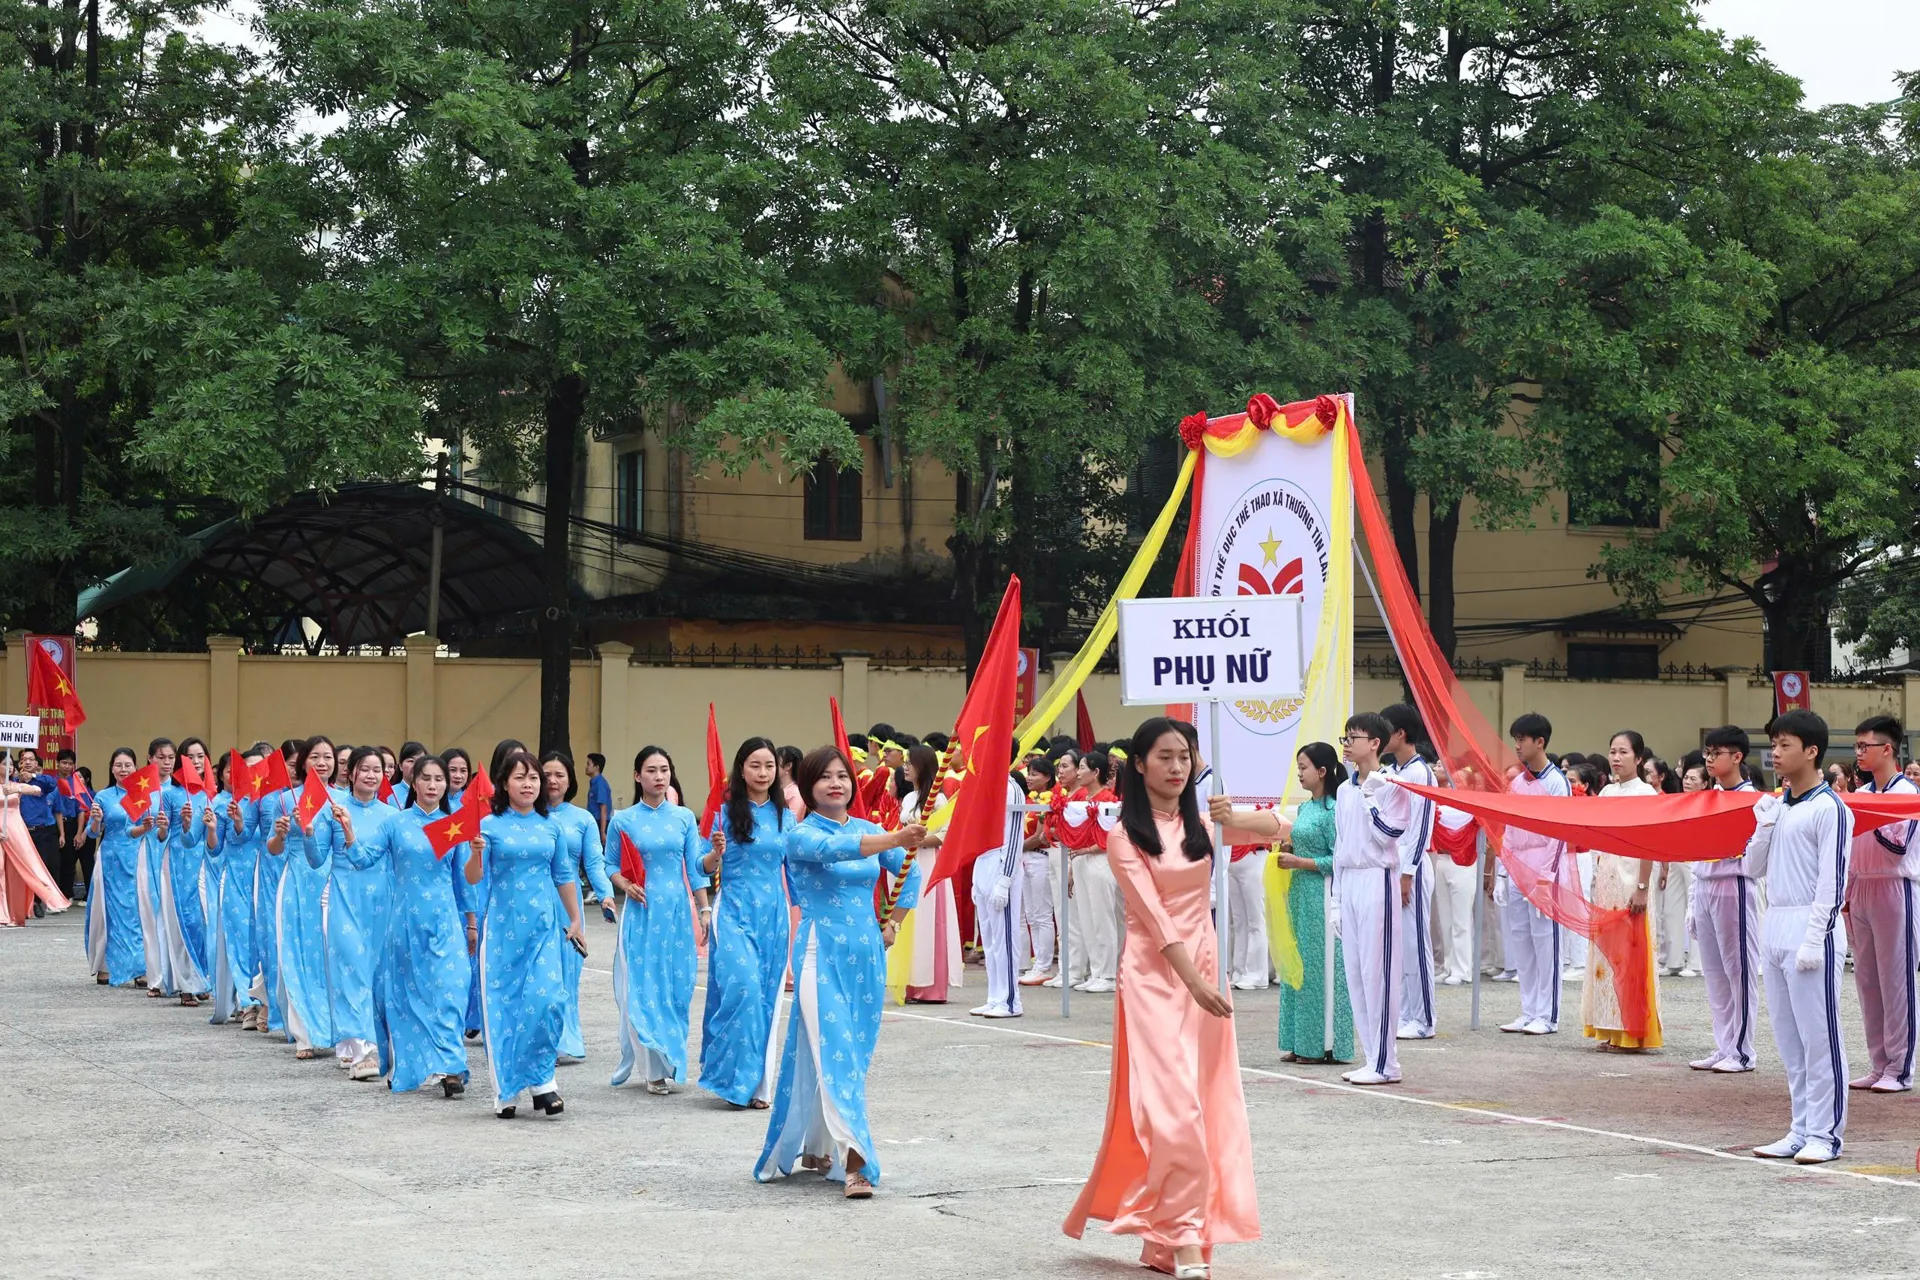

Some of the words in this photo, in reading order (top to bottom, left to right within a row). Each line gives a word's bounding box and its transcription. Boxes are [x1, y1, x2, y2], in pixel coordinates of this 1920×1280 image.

[1214, 550, 1227, 581] THỂ
[1222, 525, 1237, 555] DỤC
[1235, 499, 1251, 529] THỂ
[1250, 491, 1271, 514] THAO
[1272, 488, 1284, 507] XÃ
[1285, 493, 1315, 532] THƯỜNG
[1311, 526, 1325, 553] TÍN
[1172, 608, 1251, 640] KHỐI
[1153, 655, 1216, 691] PHỤ
[1226, 647, 1272, 684] NỮ
